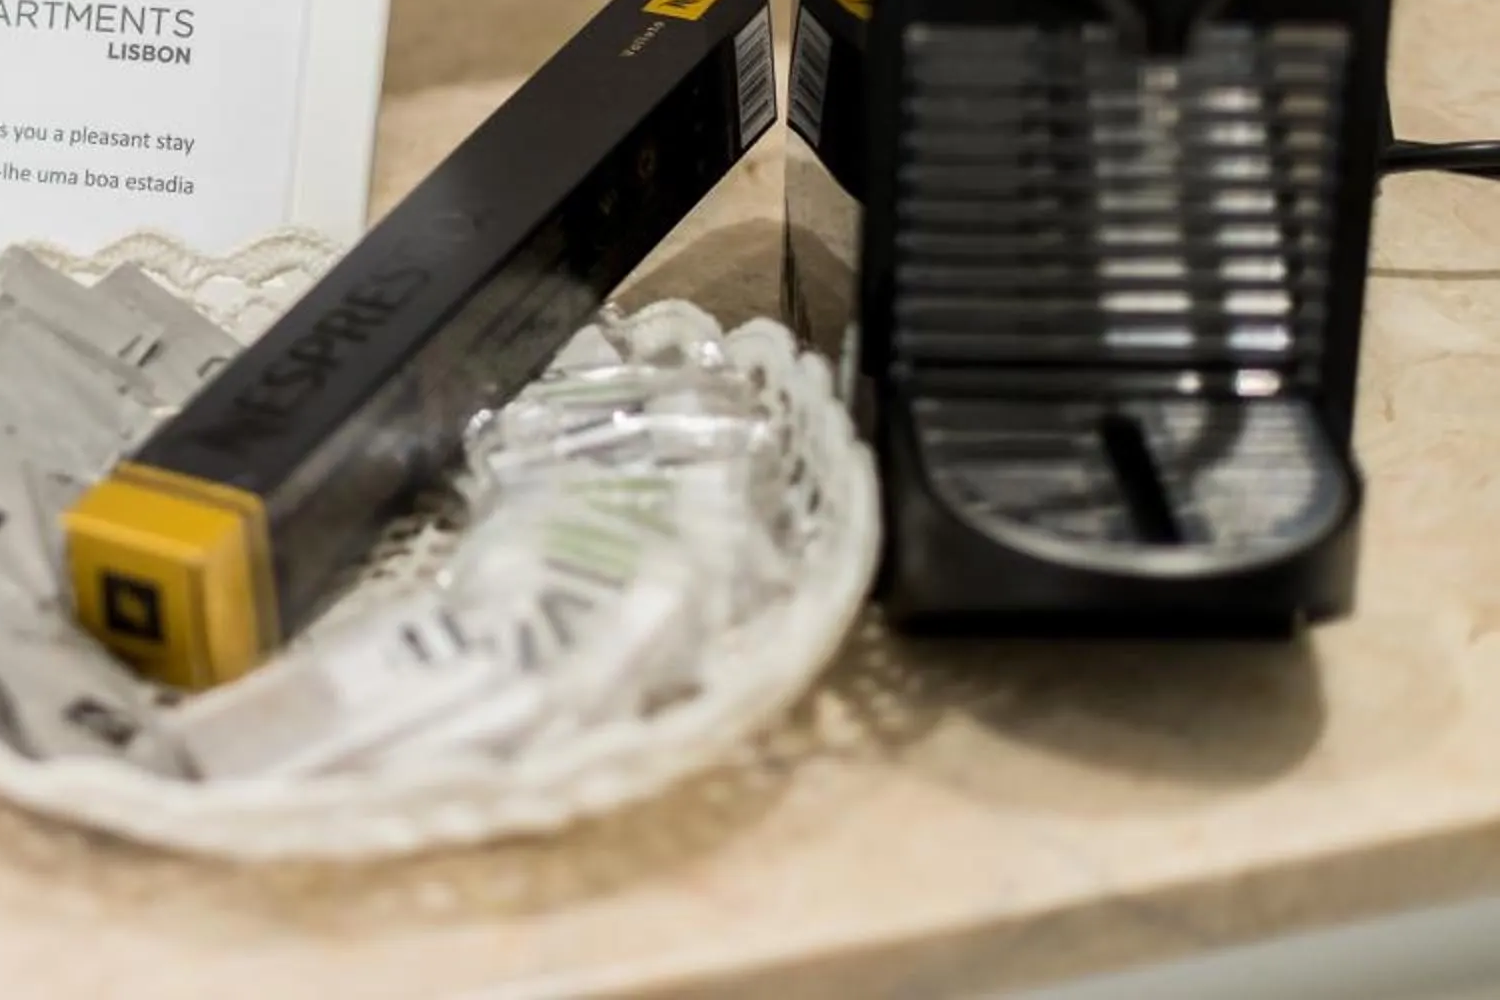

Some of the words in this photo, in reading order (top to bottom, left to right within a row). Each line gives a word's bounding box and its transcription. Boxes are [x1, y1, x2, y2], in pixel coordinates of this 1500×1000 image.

[107, 42, 192, 64] LISBON
[13, 125, 47, 143] you
[53, 129, 64, 142] a
[69, 126, 151, 149] pleasant
[156, 135, 195, 156] stay
[37, 171, 78, 186] uma
[84, 169, 120, 189] boa
[125, 176, 195, 195] estadia
